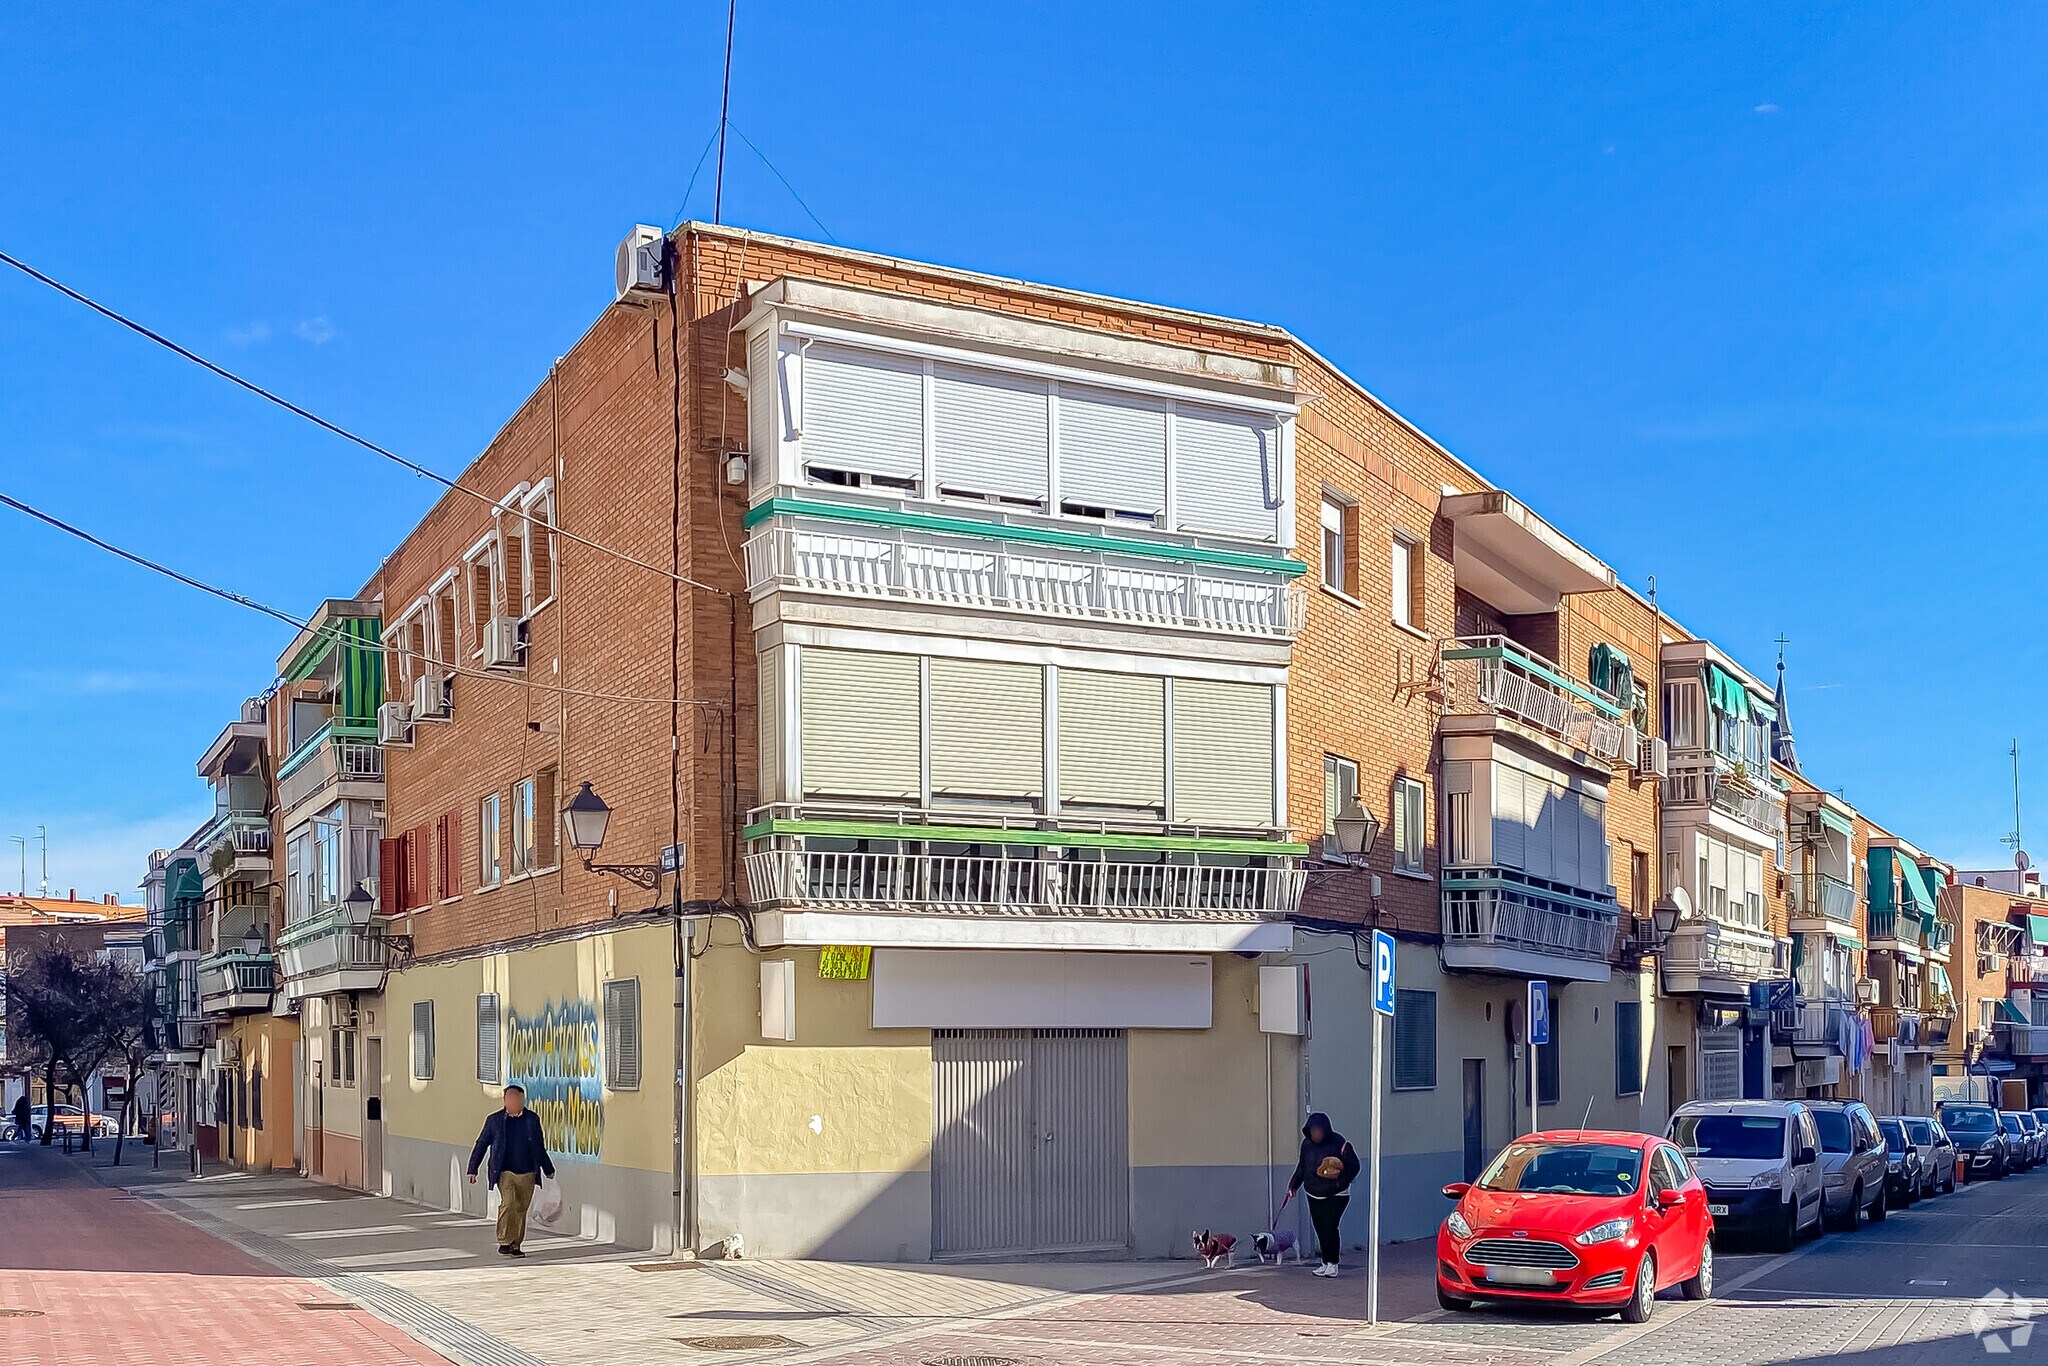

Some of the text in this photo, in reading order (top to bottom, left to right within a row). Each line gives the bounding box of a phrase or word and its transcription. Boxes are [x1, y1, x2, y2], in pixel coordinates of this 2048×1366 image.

[826, 951, 847, 962] LOCAL
[1378, 941, 1390, 1001] P
[1534, 989, 1544, 1036] P
[509, 1016, 534, 1083] Ropa
[567, 1085, 602, 1157] Mano
